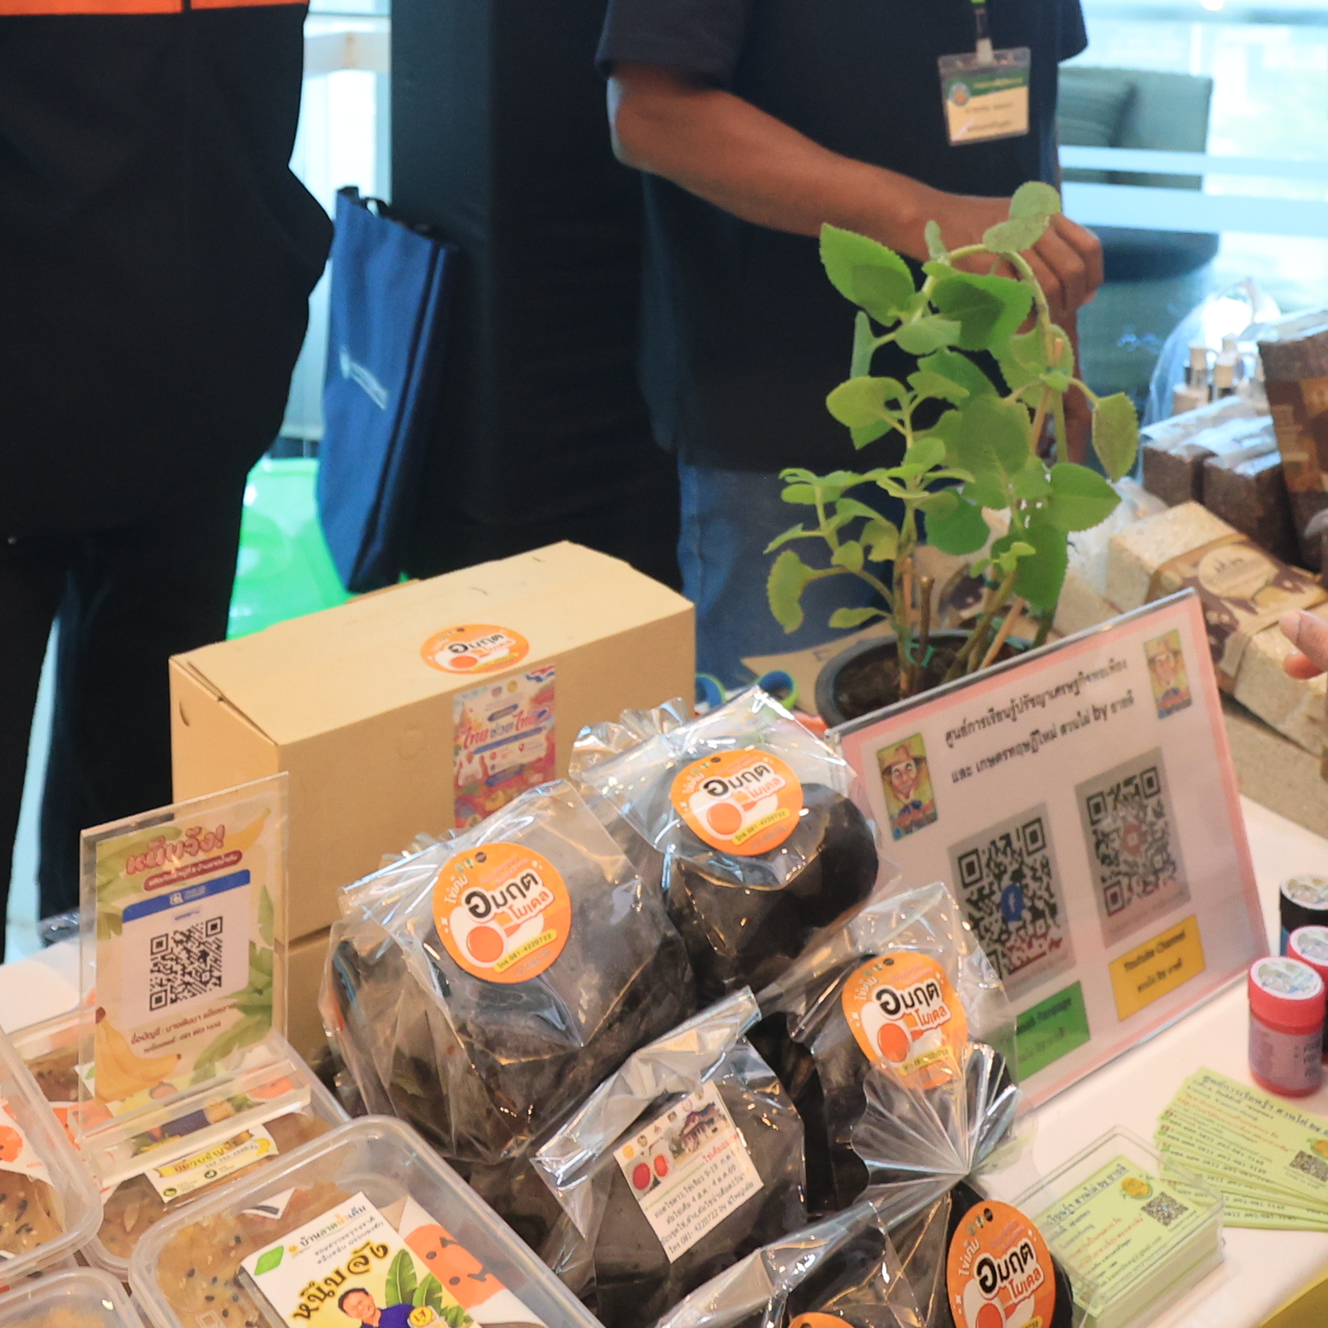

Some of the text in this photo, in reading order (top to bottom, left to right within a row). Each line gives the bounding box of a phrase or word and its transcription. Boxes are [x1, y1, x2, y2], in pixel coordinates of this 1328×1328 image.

[703, 765, 770, 796] อมฤต
[746, 777, 782, 799] โมเดล
[444, 874, 469, 904] ไข่เค็ม
[465, 872, 539, 919] อมฤต
[508, 890, 550, 920] โมเดล
[876, 982, 939, 1015] อมฤต
[915, 1005, 948, 1027] โมเดล
[958, 1238, 981, 1276] ไข่เค็ม
[977, 1242, 1034, 1294] อมฤต
[293, 1241, 390, 1322] หนึบ จัง
[1008, 1267, 1042, 1299] โมเดล
